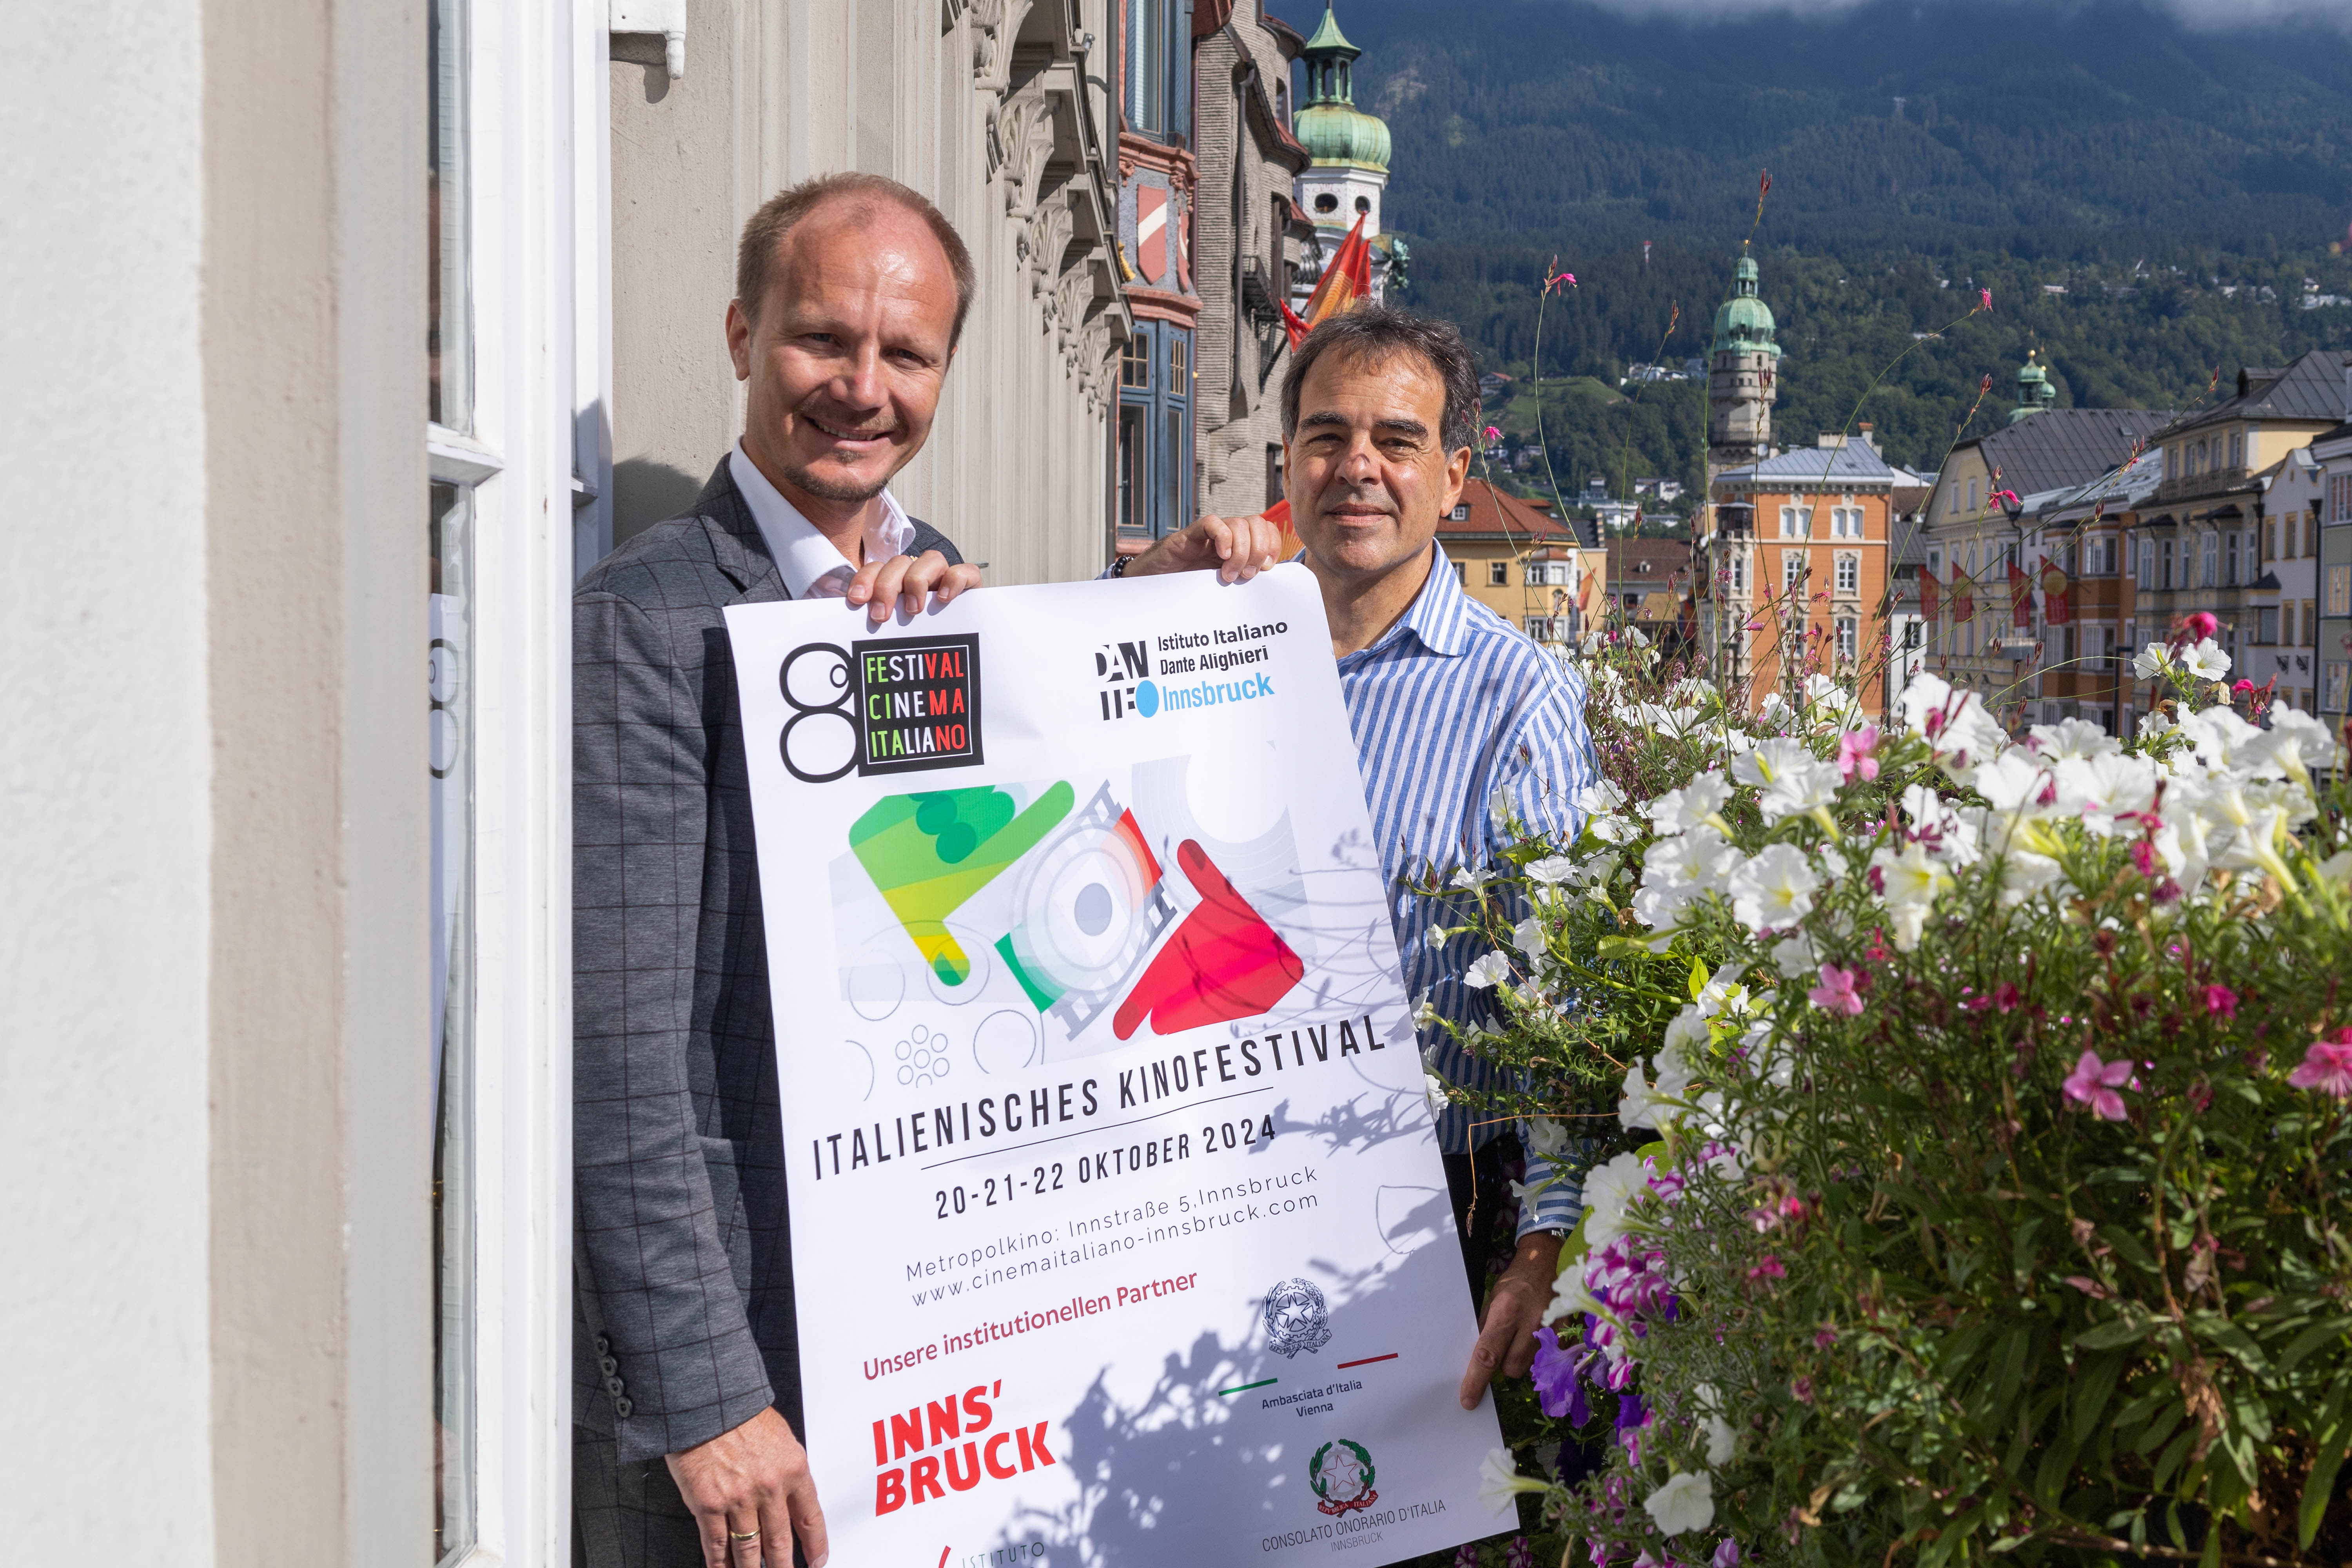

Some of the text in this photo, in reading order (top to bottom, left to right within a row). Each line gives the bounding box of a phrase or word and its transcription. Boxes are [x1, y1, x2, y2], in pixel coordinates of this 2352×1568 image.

[1158, 622, 1288, 651] Istituto Italiano
[867, 652, 964, 683] FESTIVAL
[1160, 645, 1268, 675] Dante Alighieri
[869, 688, 964, 720] CINEMA
[1163, 673, 1275, 711] Innsbruck
[871, 724, 965, 757] ITALIANO
[813, 1014, 1385, 1180] ITALIENISCHES KINOFESTIVAL
[936, 1114, 1275, 1219] 20-21-22 OKTOBER 2024
[907, 1229, 1058, 1281] Metropolkino:
[1069, 1202, 1168, 1237] Innstraße
[912, 1195, 1317, 1306] www.cinemaitaliano-innsbruck.com
[864, 1273, 1197, 1380] Unsere institutionellen Partner
[1270, 1334, 1330, 1353] REPVBBLICA ITALIANA
[1263, 1381, 1362, 1409] Ambasciata d'Italia
[1296, 1403, 1333, 1417] Vienna
[875, 1421, 1056, 1517] BRUCK
[1319, 1494, 1377, 1513] REPVBBLICA ITALIANA
[1263, 1525, 1332, 1552] CONSOLATO
[1336, 1511, 1395, 1535] ONORARIO
[1330, 1532, 1383, 1552] INNSBRUCK
[962, 1542, 1044, 1568] ISTITUTO
